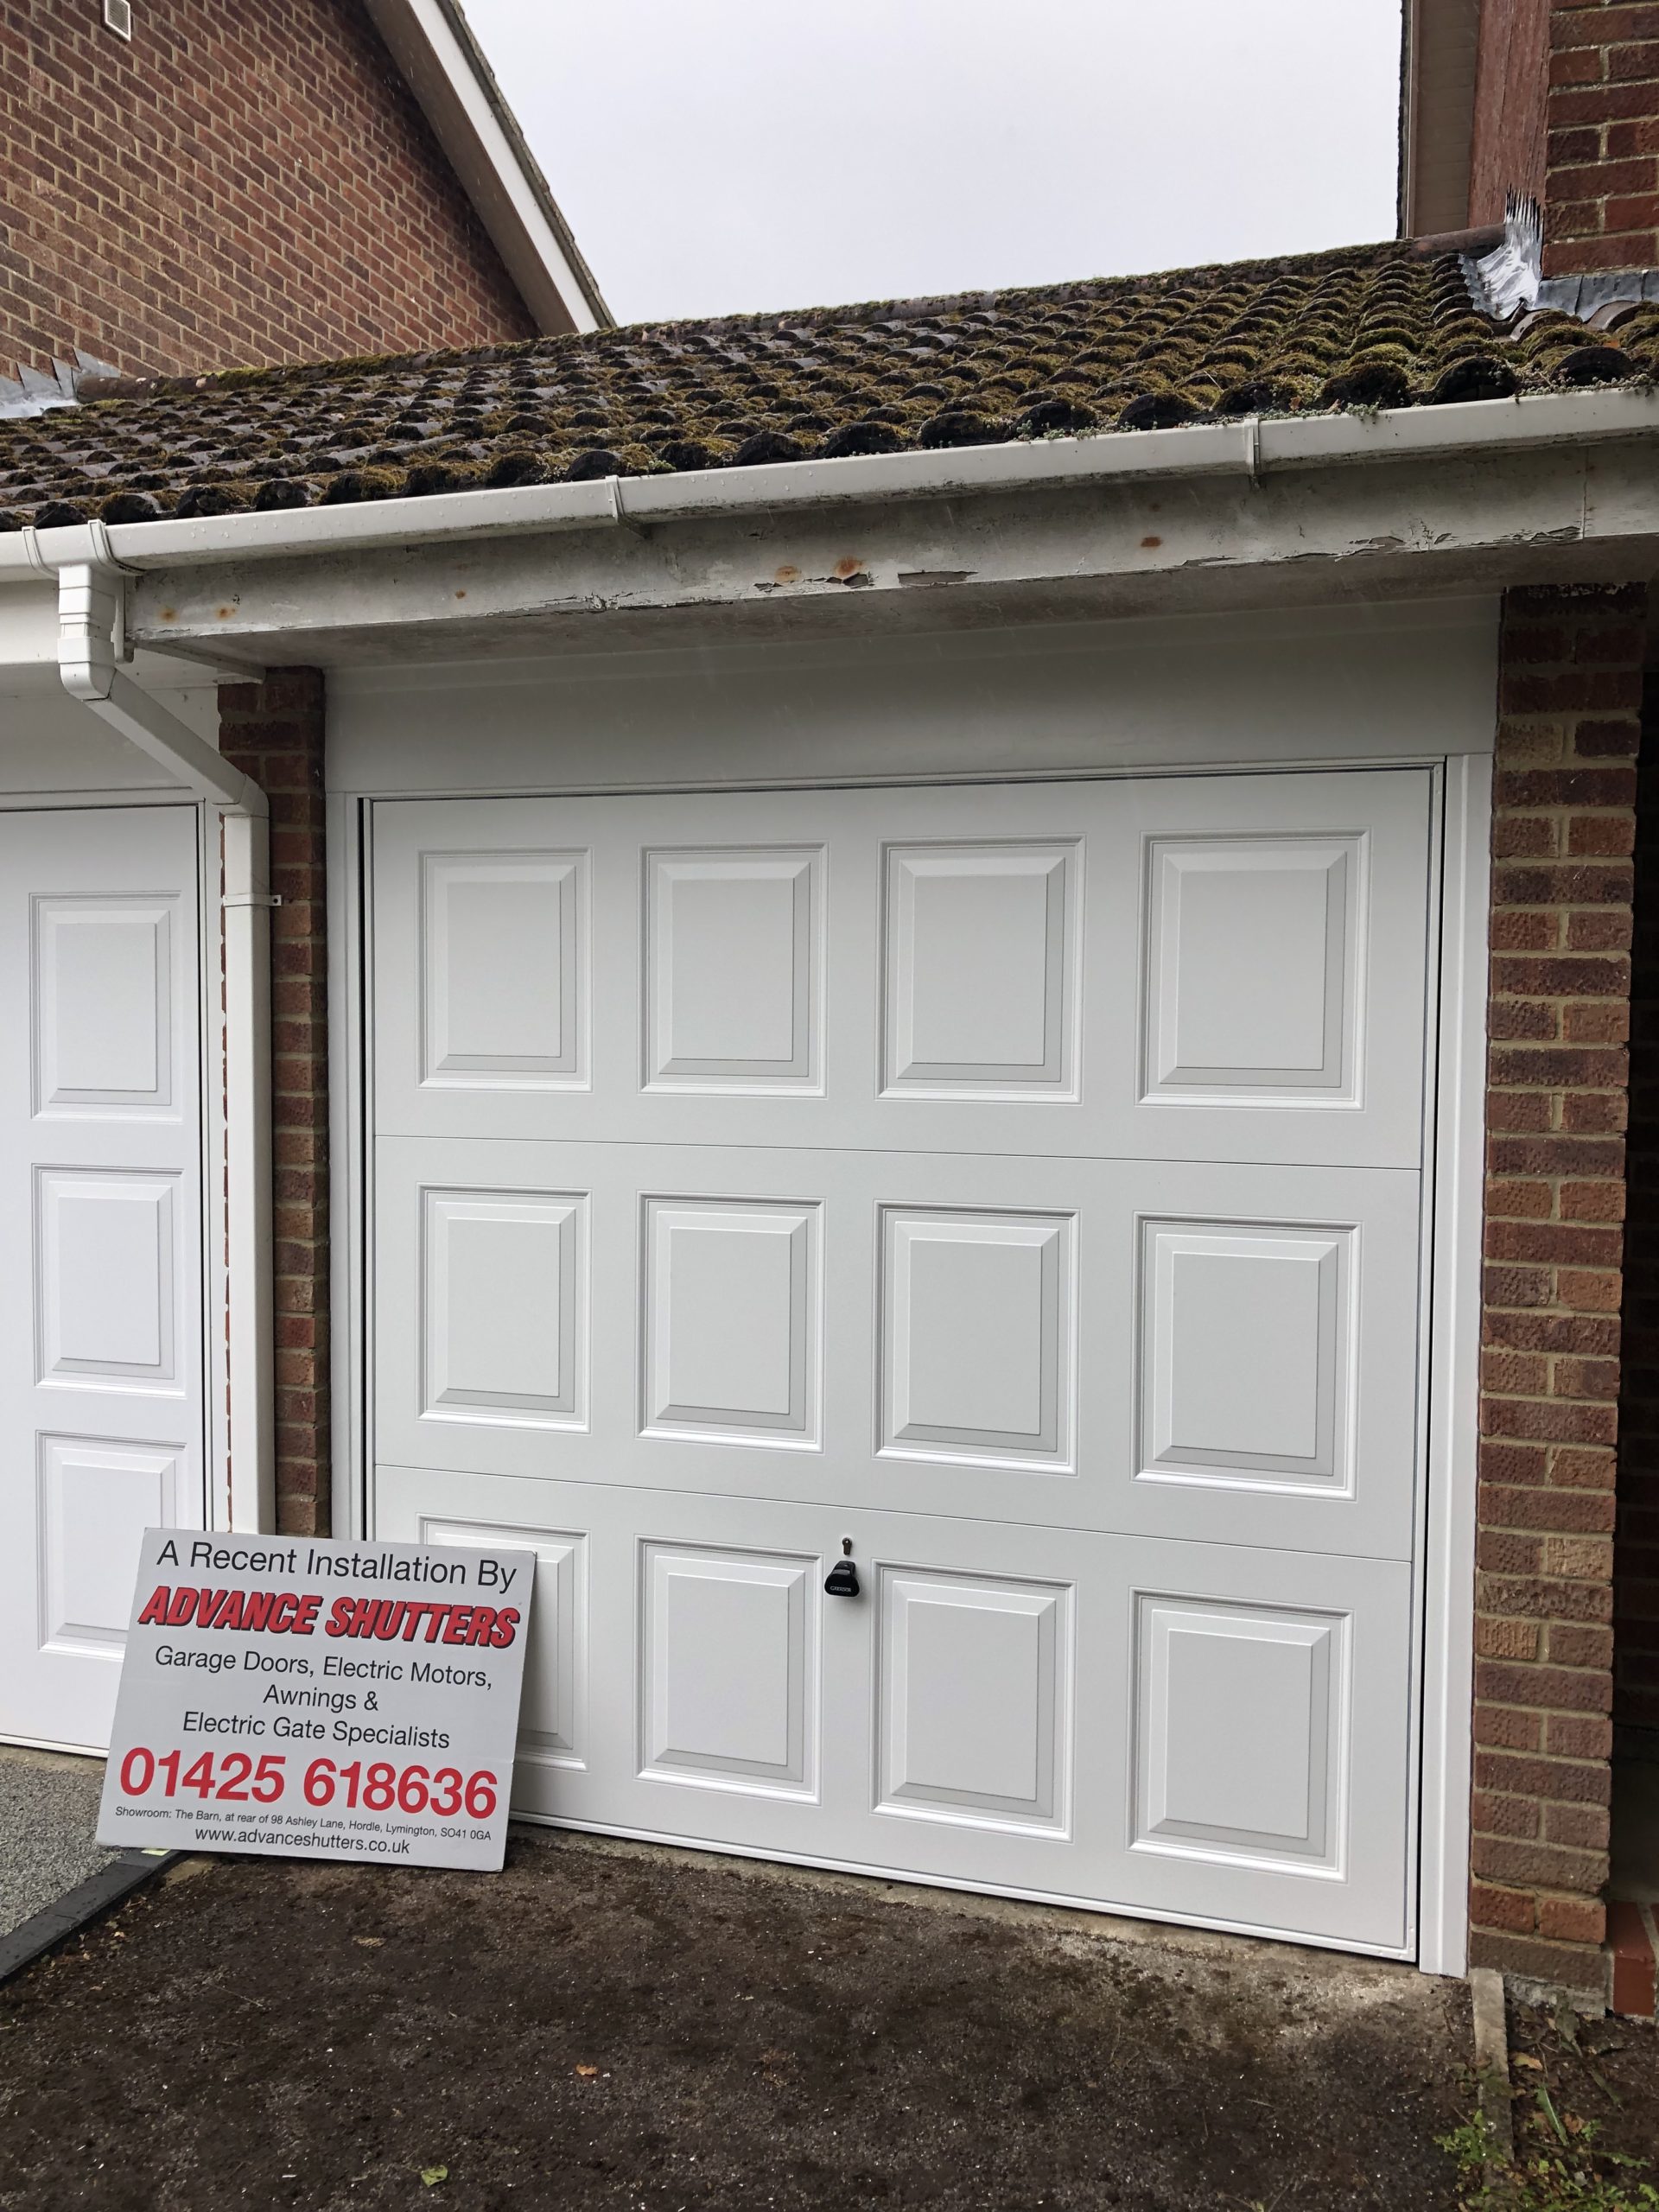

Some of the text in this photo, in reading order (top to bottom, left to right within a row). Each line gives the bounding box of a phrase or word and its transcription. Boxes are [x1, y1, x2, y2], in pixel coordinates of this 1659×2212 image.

[156, 1540, 518, 1595] A Recent Installation By
[138, 1586, 520, 1649] ADVANCE SHUTTERS
[155, 1645, 492, 1691] Garage Doors, Electric Motors,
[262, 1684, 379, 1713] Awnings &
[182, 1711, 450, 1749] Electric Gate Specialists
[120, 1746, 497, 1819] 01425 618636
[115, 1806, 492, 1840] Showroom: The Barn, at rear of 98 Ashley Lane, Hordle, Lymington, SO41 0GA
[194, 1828, 410, 1854] www.advanceshutters.co.uk
